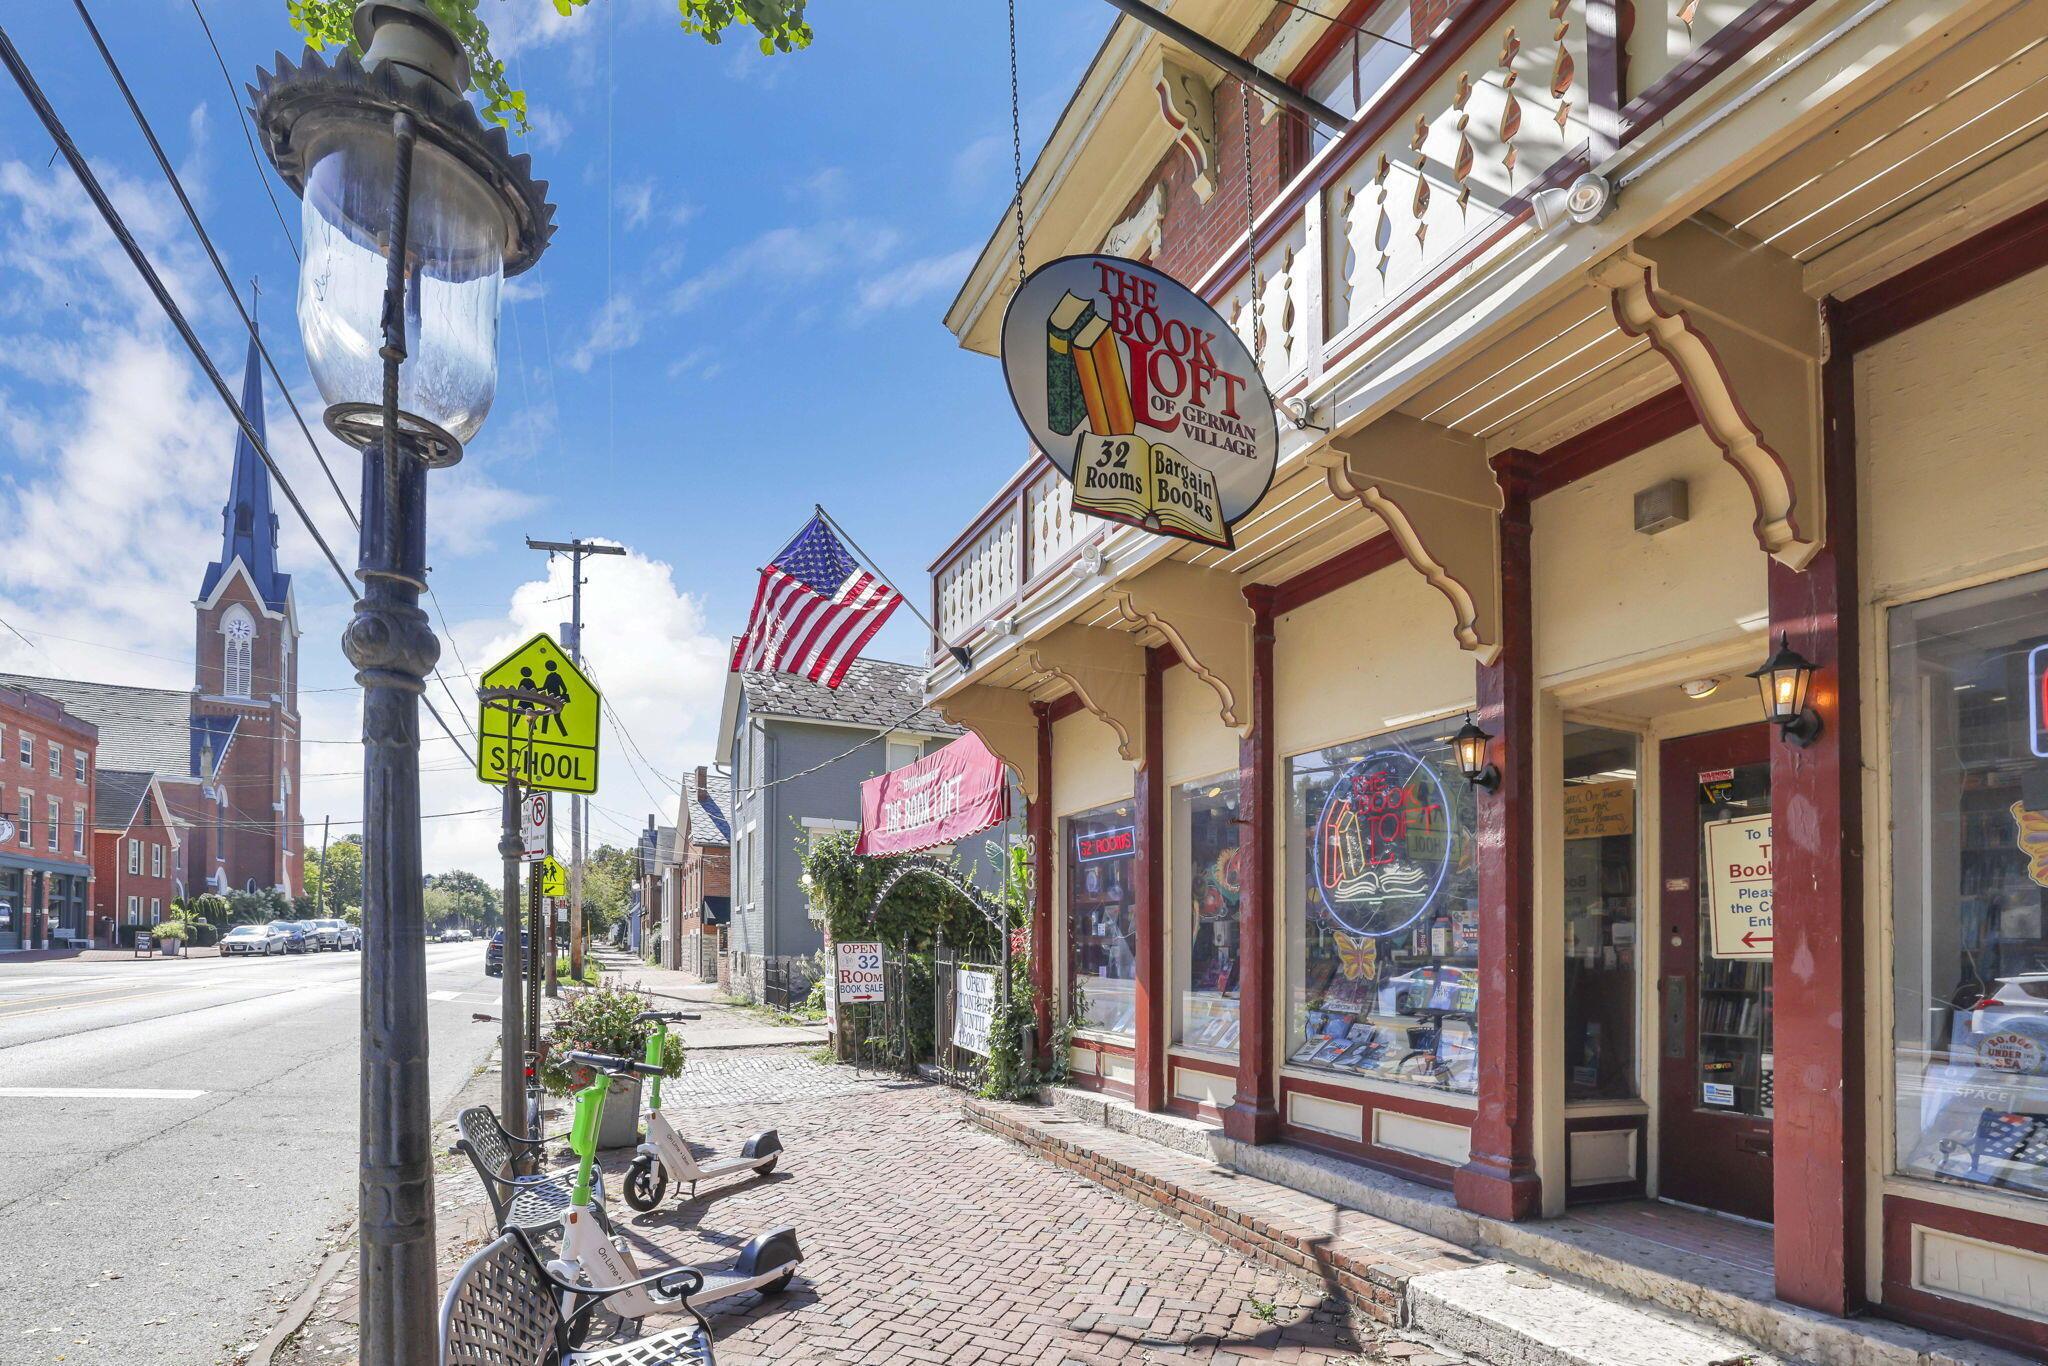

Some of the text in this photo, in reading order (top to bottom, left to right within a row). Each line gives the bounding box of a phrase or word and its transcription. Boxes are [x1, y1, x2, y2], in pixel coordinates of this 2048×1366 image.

[1093, 261, 1160, 312] THE
[1107, 295, 1217, 370] BOOK
[1119, 336, 1246, 433] LOFT
[1151, 395, 1256, 442] OF GERMAN
[1182, 422, 1257, 460] VILLAGE
[1096, 440, 1130, 469] 32
[1085, 465, 1143, 495] Rooms
[1154, 450, 1213, 500] Bargain
[1157, 478, 1213, 523] Books
[1745, 829, 1761, 840] To
[1738, 887, 1774, 900] Pleas
[1730, 903, 1753, 914] the
[842, 944, 878, 954] OPEN
[858, 955, 880, 969] 32
[840, 969, 882, 983] ROOM
[840, 983, 884, 993] BOOK SALE
[966, 975, 987, 994] OPEN
[1988, 1048, 2022, 1059] UNDER
[1955, 1087, 2009, 1102] SPACE
[598, 1247, 608, 1260] On
[605, 1258, 619, 1277] Lime
